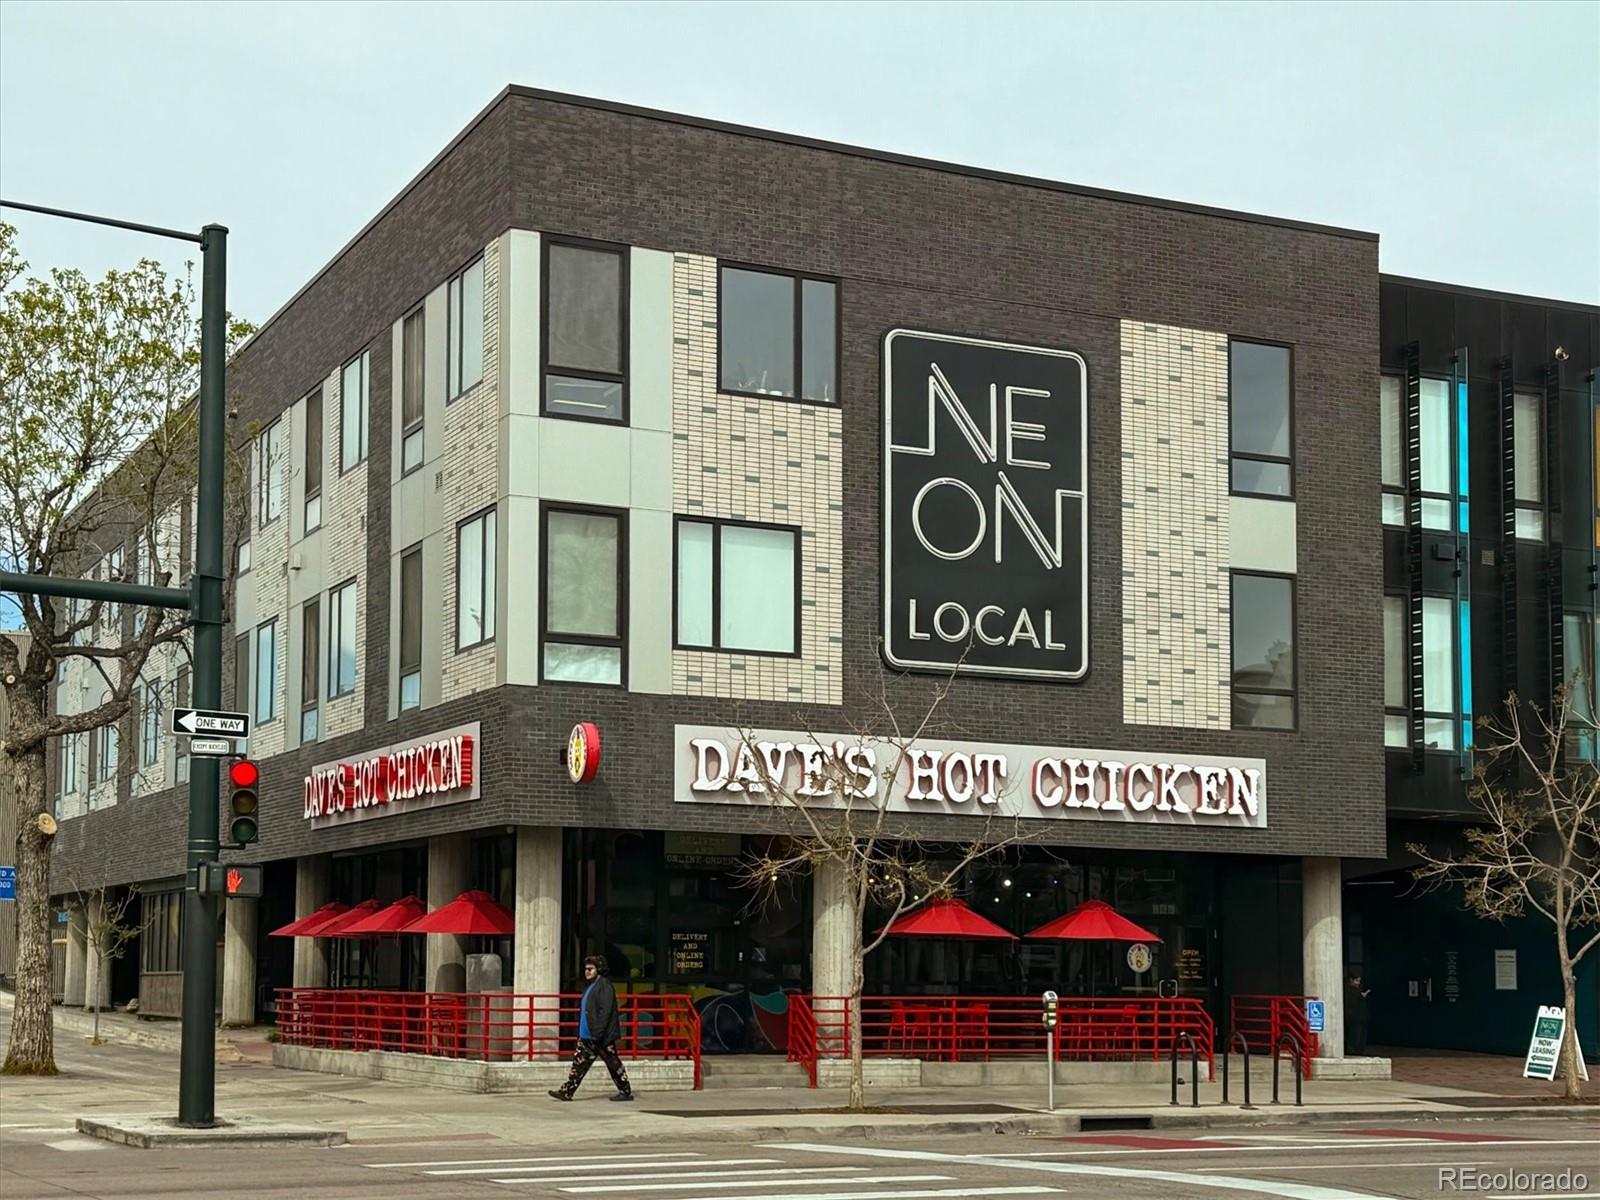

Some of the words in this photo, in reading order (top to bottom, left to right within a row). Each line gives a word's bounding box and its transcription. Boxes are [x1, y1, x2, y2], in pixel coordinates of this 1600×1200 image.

[909, 598, 1066, 650] LOCAL
[196, 718, 217, 728] ONE
[220, 719, 241, 730] WAY
[304, 764, 346, 819] DAVE'S
[352, 757, 380, 810] HOT
[387, 736, 465, 802] CHICKEN
[690, 737, 878, 799] DAVE'S
[905, 749, 1008, 804] HOT
[1032, 757, 1261, 817] CHICKEN
[1531, 1047, 1556, 1056] LEASING
